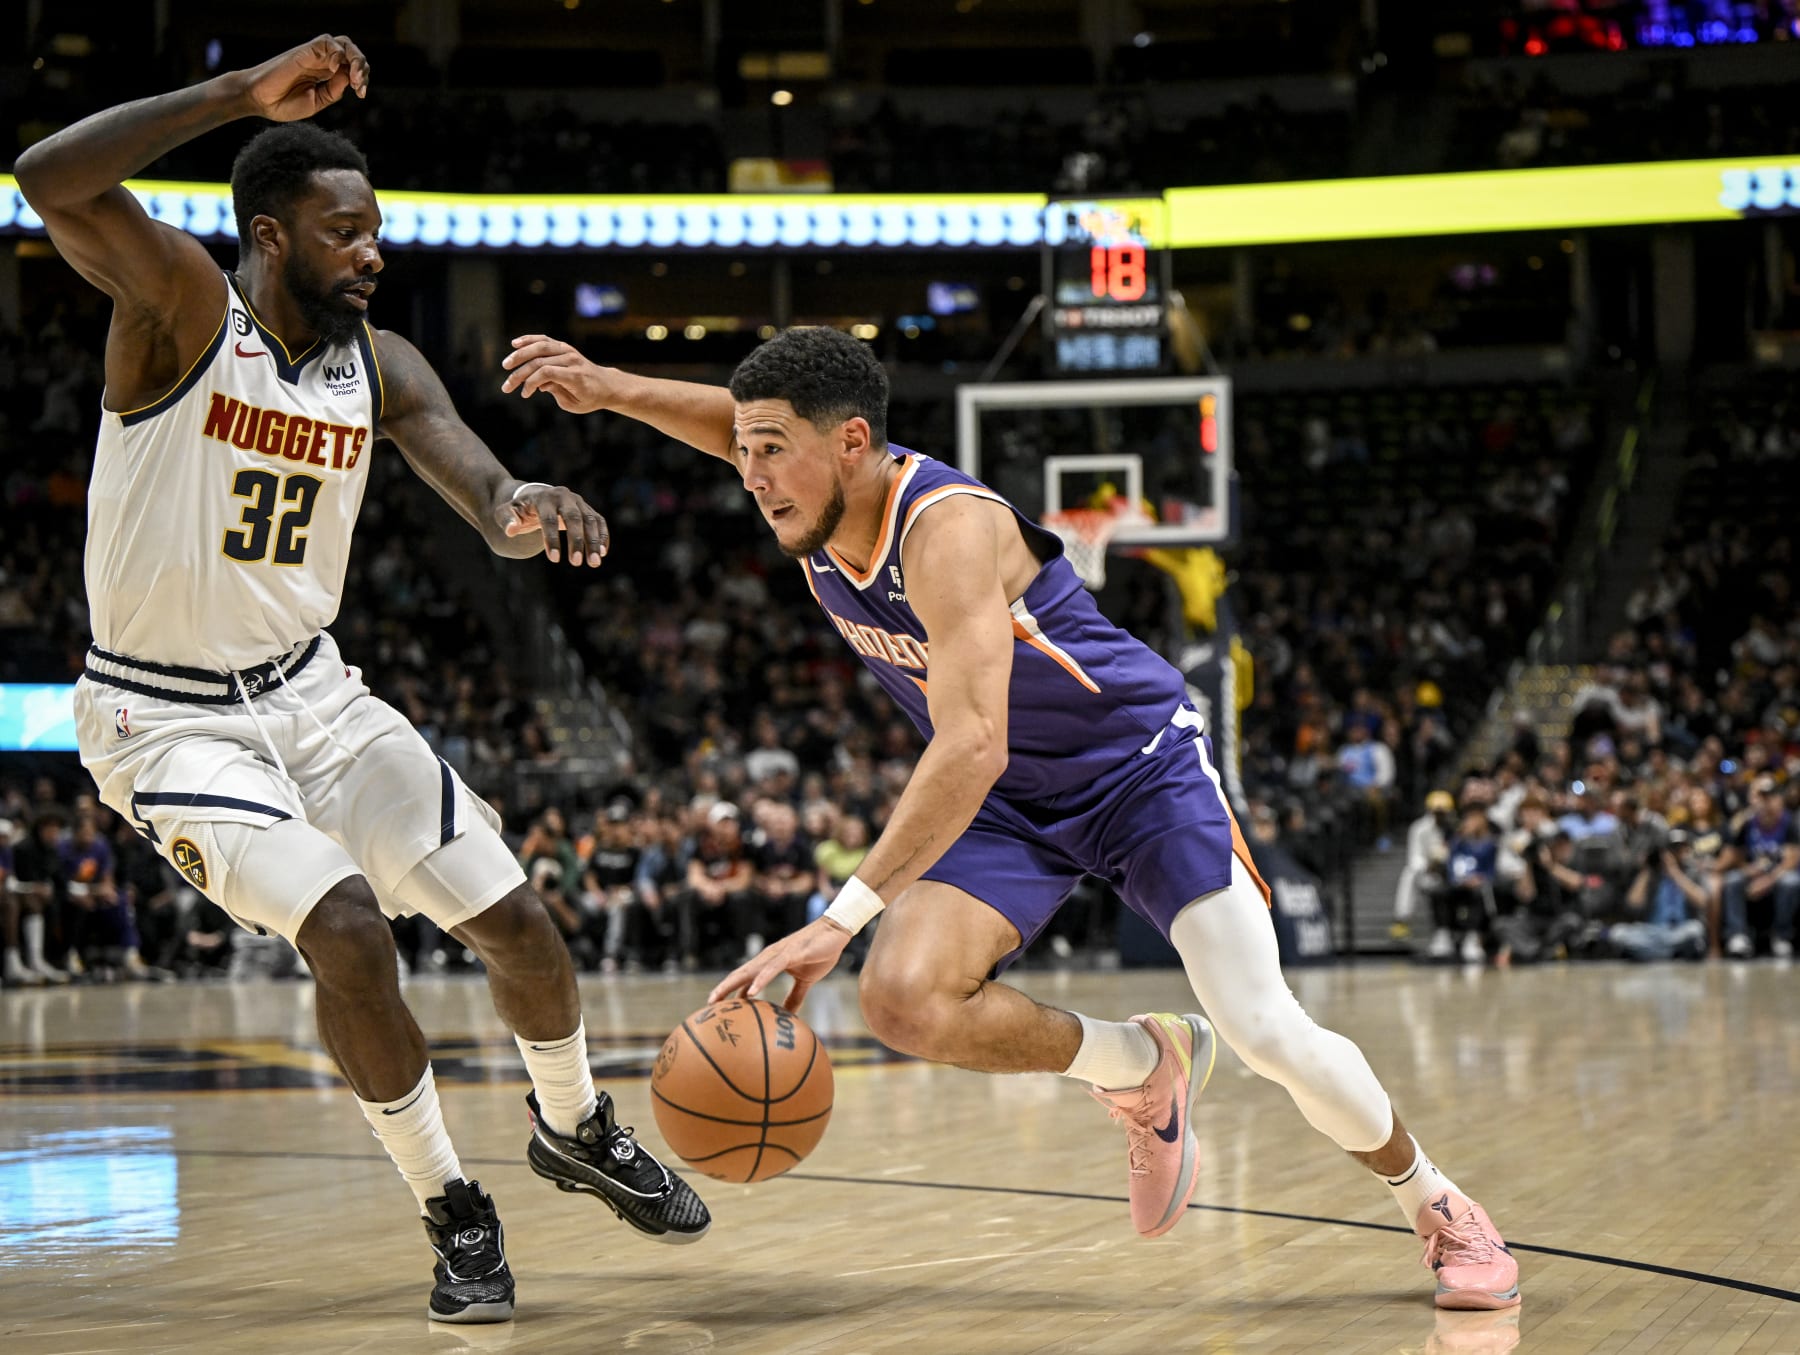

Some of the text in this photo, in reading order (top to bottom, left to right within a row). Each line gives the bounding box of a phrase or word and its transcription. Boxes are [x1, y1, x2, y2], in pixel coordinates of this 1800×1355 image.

[1091, 243, 1146, 301] 18
[323, 363, 356, 381] WU
[324, 379, 360, 391] Western
[332, 388, 357, 397] Union
[202, 391, 368, 471] NUGGETS
[222, 467, 326, 567] 32
